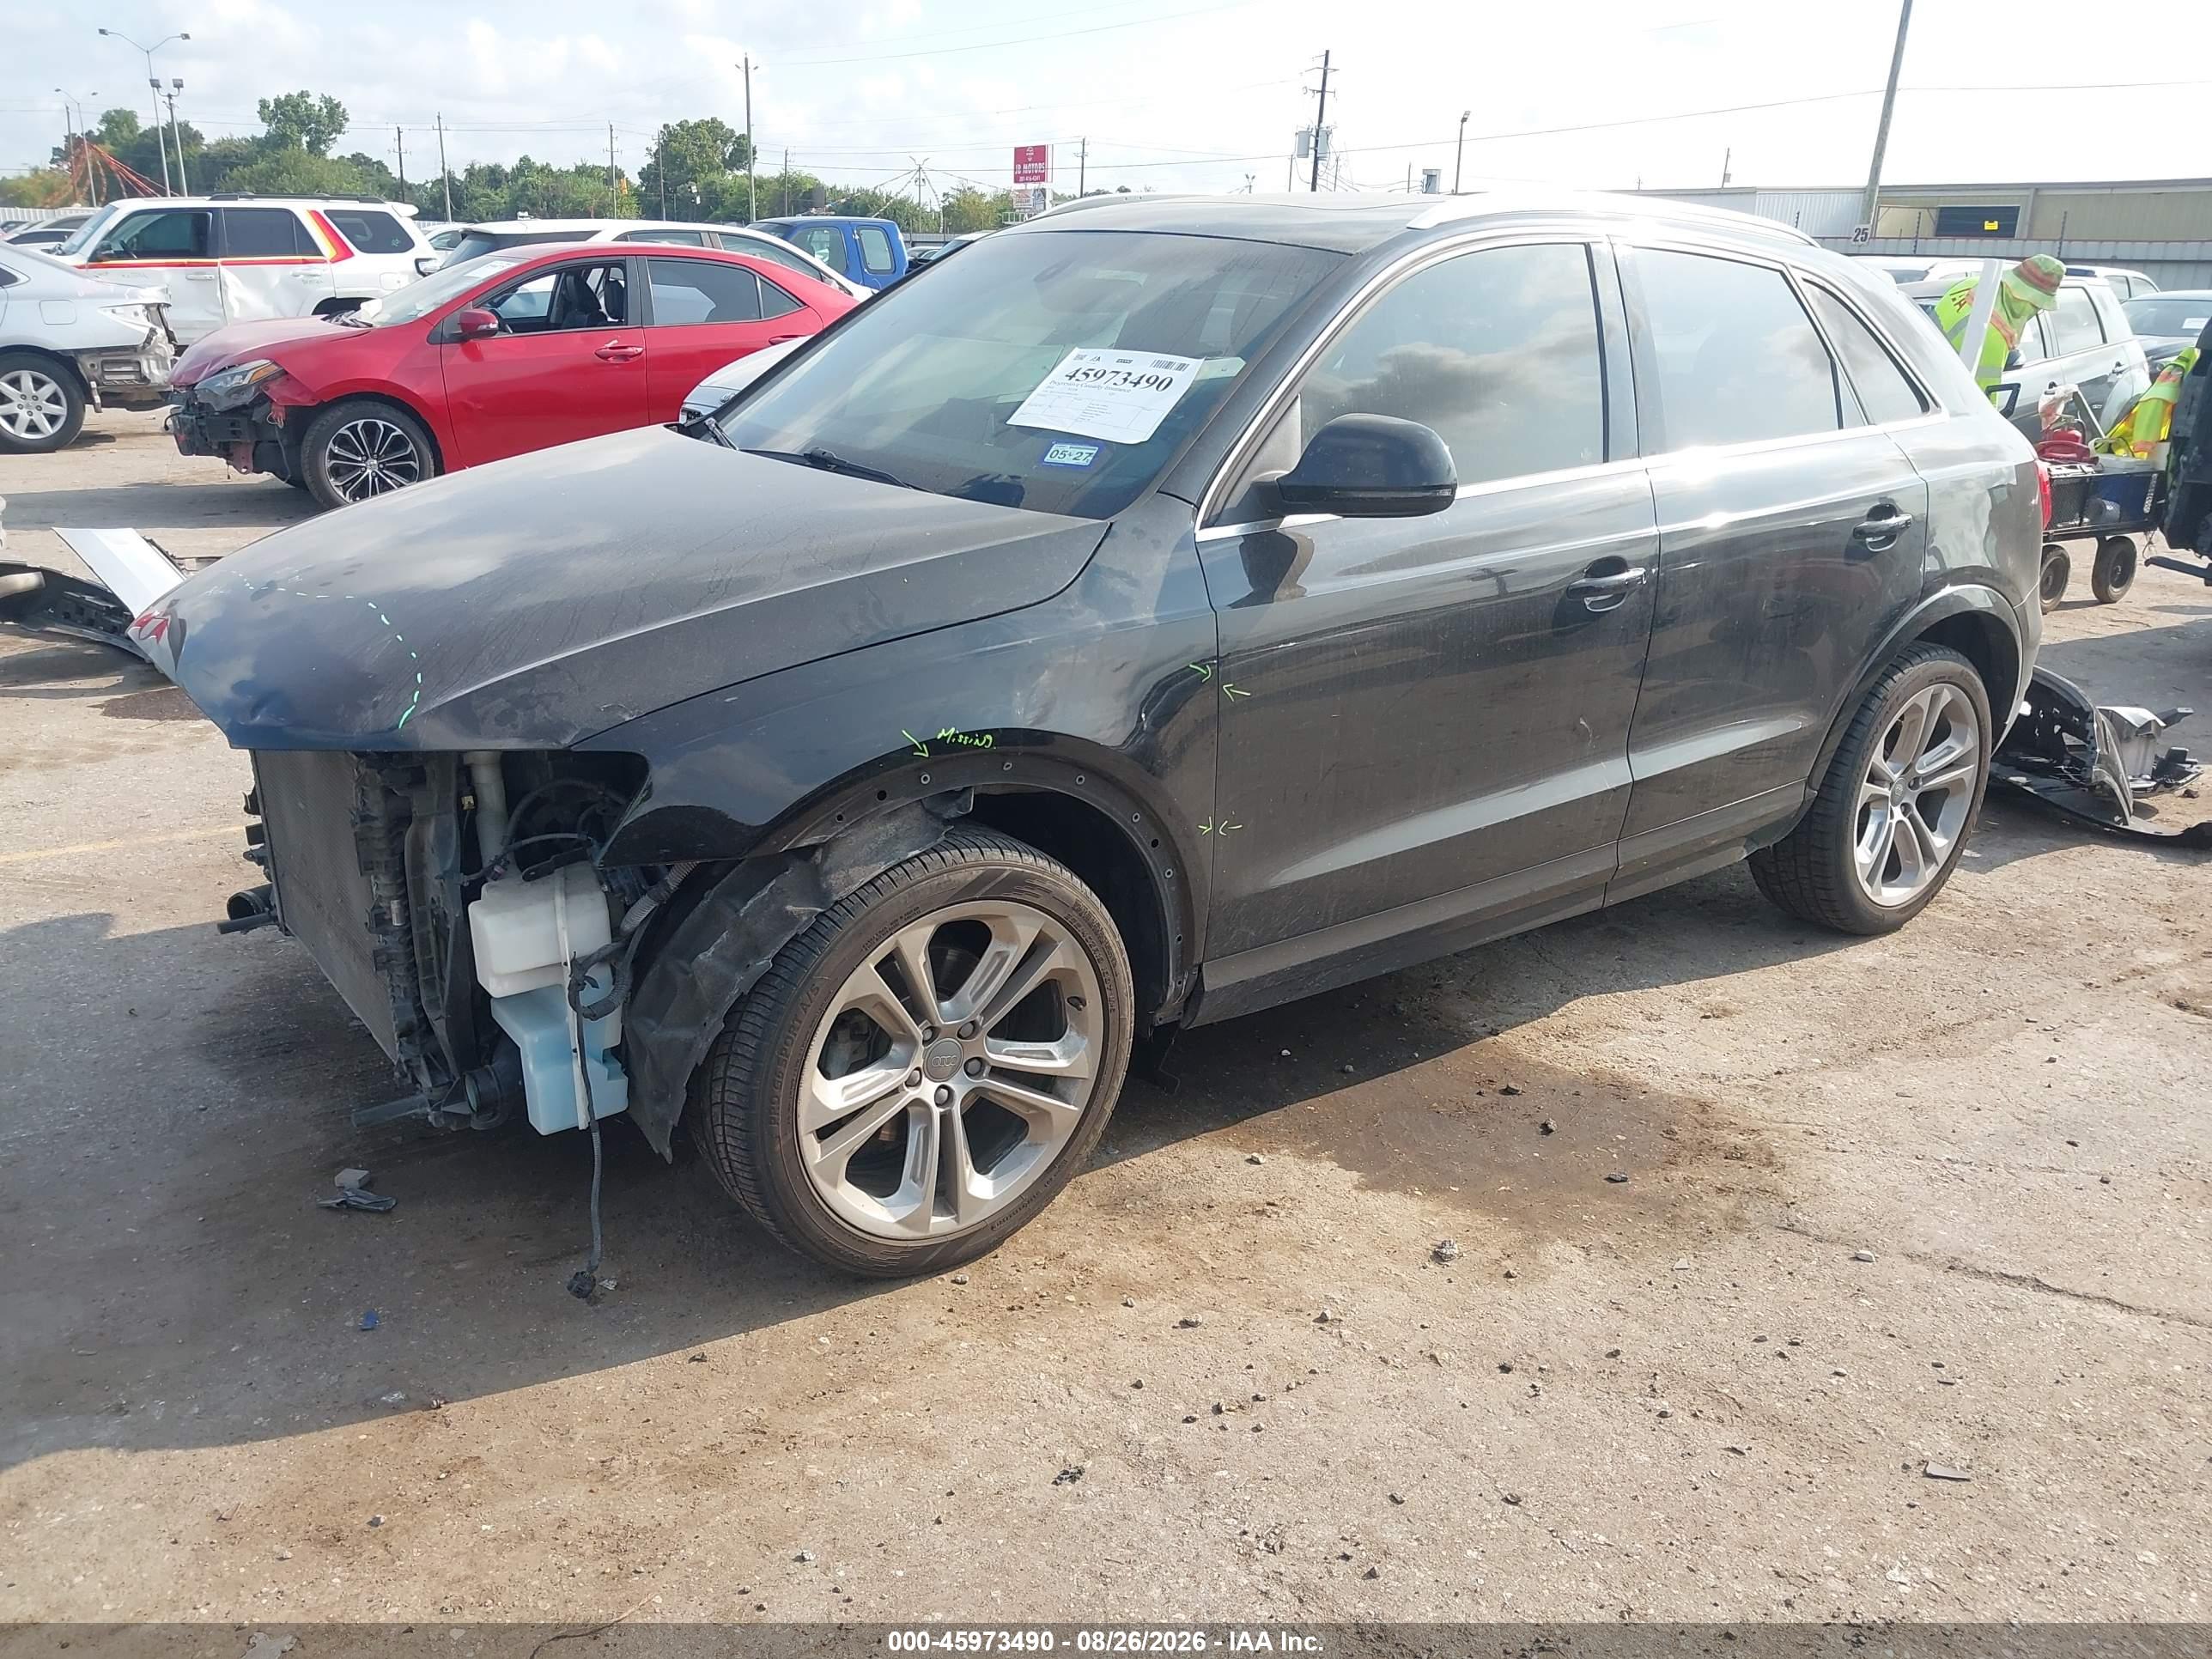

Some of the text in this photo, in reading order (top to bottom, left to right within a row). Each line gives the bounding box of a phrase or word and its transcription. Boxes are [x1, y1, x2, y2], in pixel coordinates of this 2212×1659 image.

[1023, 162, 1045, 174] MOTORS
[1852, 228, 1869, 242] 25
[1065, 367, 1174, 392] 45973490
